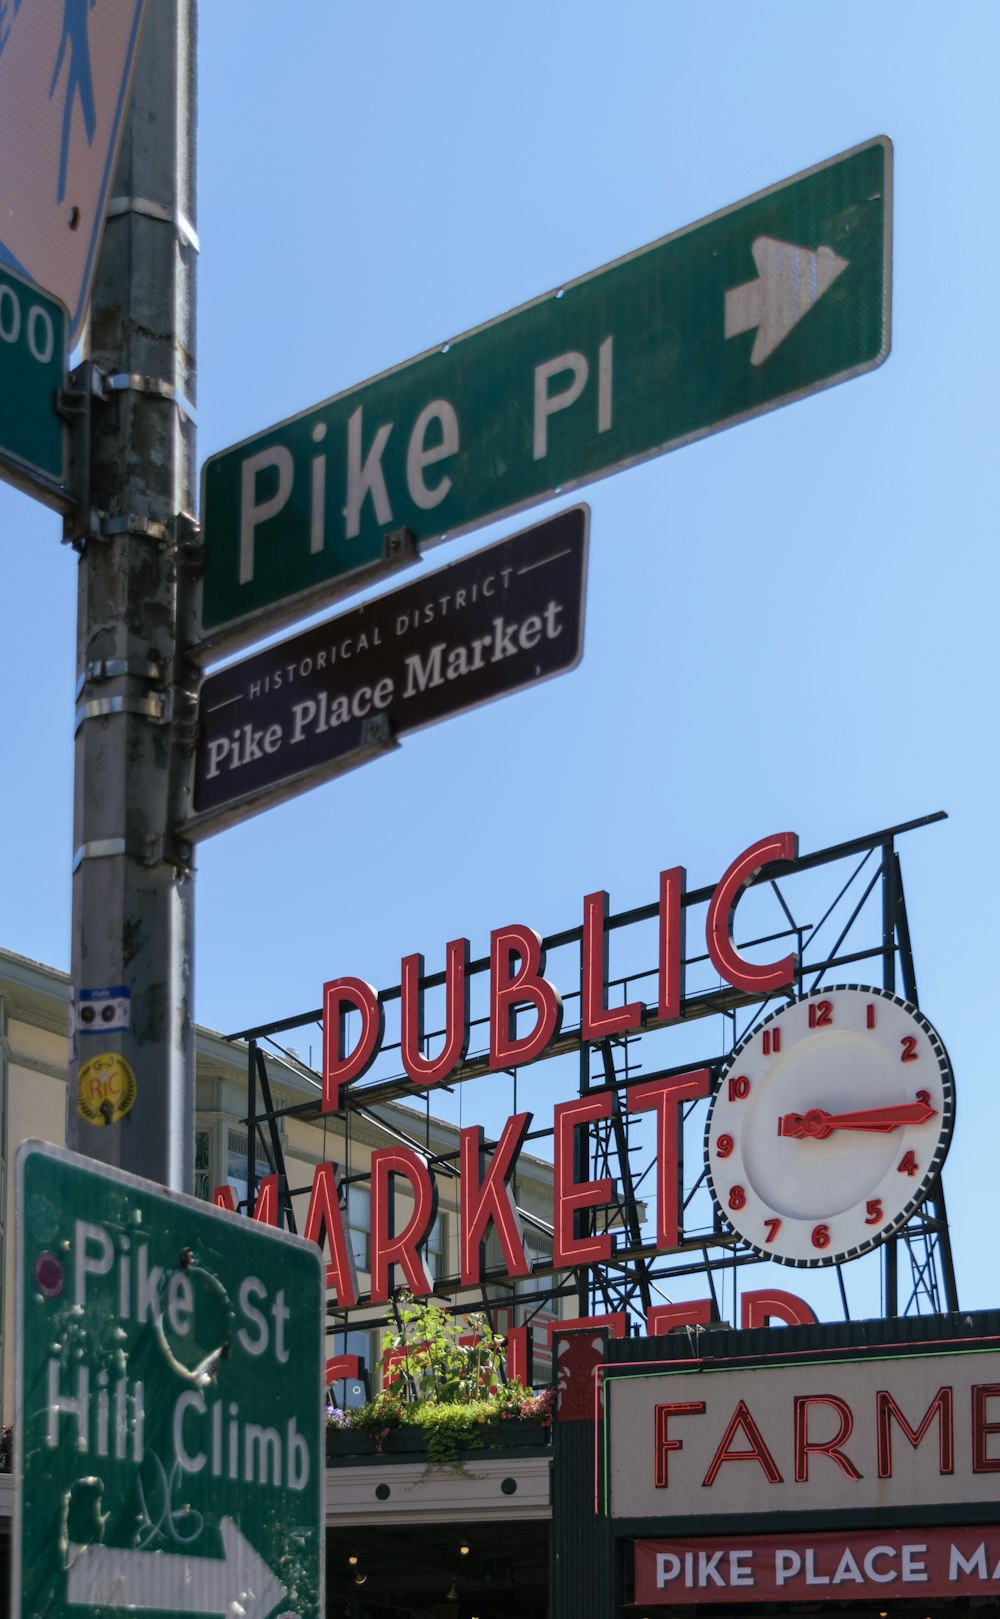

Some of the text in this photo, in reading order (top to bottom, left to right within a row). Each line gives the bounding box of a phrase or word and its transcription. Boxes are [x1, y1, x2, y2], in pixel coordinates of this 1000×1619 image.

[239, 335, 613, 585] Pike Pl
[249, 569, 513, 699] HISTORICAL DISTRICT
[206, 600, 563, 780] Pike Place Market
[322, 831, 799, 1114] PUBLIC
[808, 1000, 833, 1028] 12
[866, 1004, 875, 1029] 1
[762, 1027, 781, 1055] 11
[900, 1036, 918, 1063] 2
[728, 1076, 750, 1102] 10
[716, 1134, 734, 1159] 9
[897, 1150, 919, 1176] 4
[214, 1066, 712, 1308] ARKET
[728, 1185, 746, 1211] 8
[865, 1199, 883, 1224] 5
[763, 1218, 782, 1243] 7
[811, 1224, 830, 1249] 6
[74, 1219, 194, 1336] Pike
[238, 1276, 291, 1363] St
[47, 1359, 311, 1490] Hill Climb
[656, 1542, 1000, 1588] PIKE PLACE M
